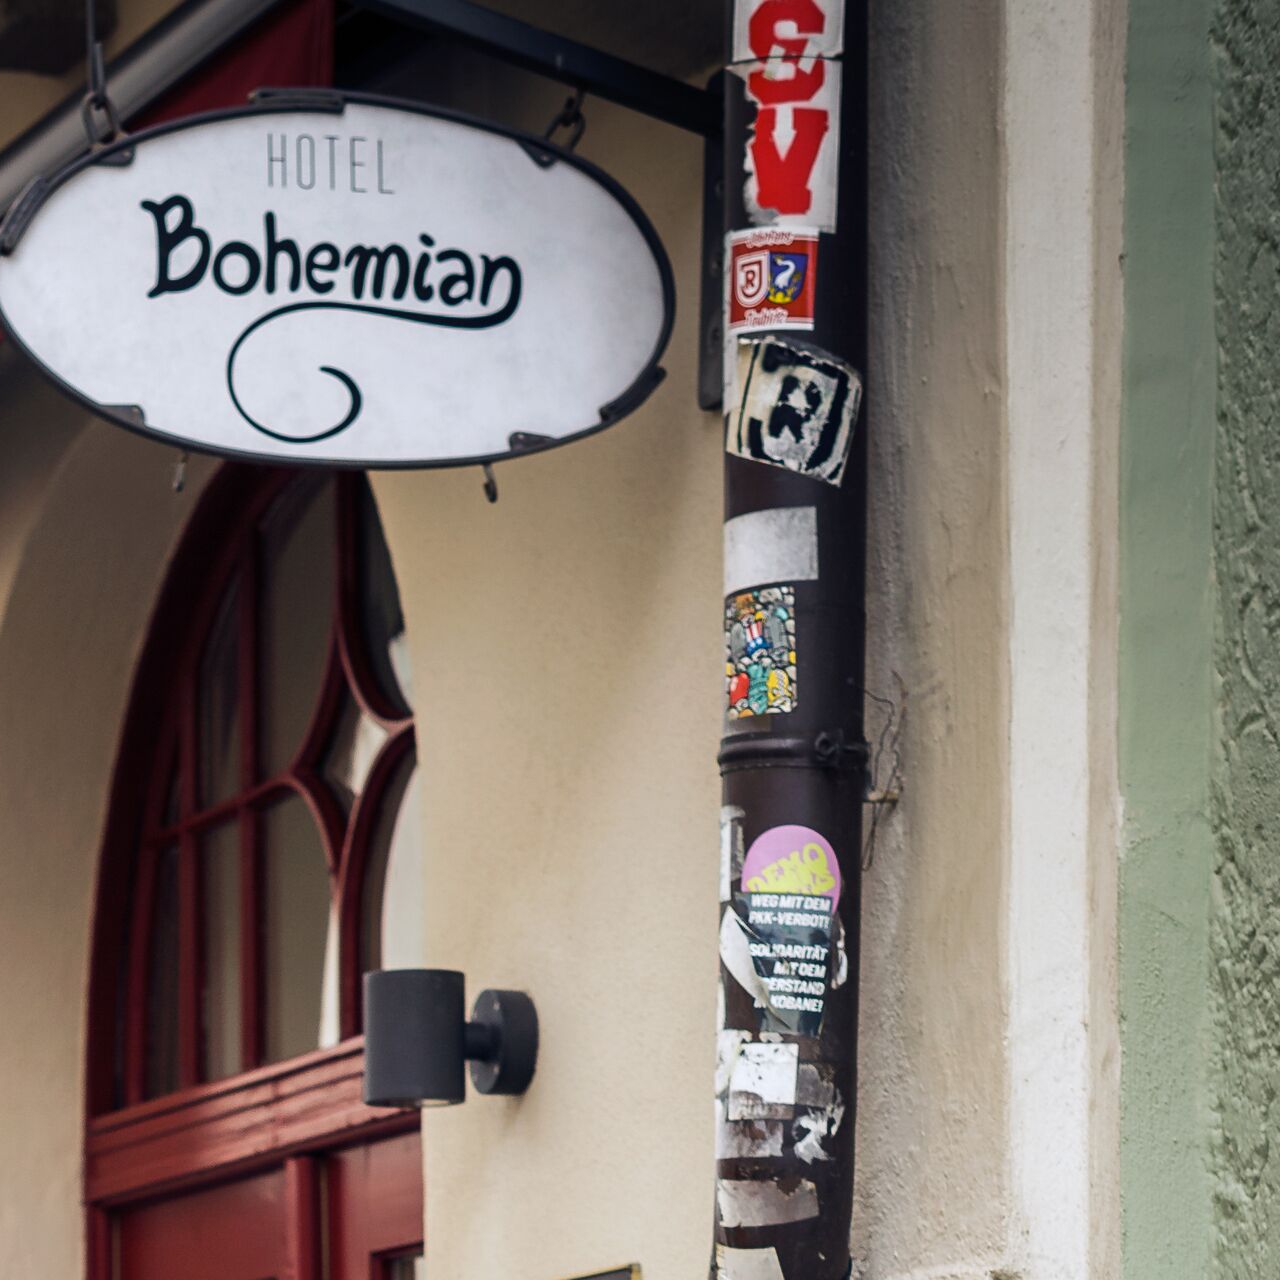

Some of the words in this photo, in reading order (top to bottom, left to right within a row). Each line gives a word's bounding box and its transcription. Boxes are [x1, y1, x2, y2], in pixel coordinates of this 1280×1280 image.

[265, 132, 395, 195] HOTEL
[140, 194, 522, 330] Bohemian
[751, 894, 779, 908] WEG
[779, 895, 803, 909] MIT
[803, 897, 831, 912] DEM
[798, 962, 827, 978] DEM
